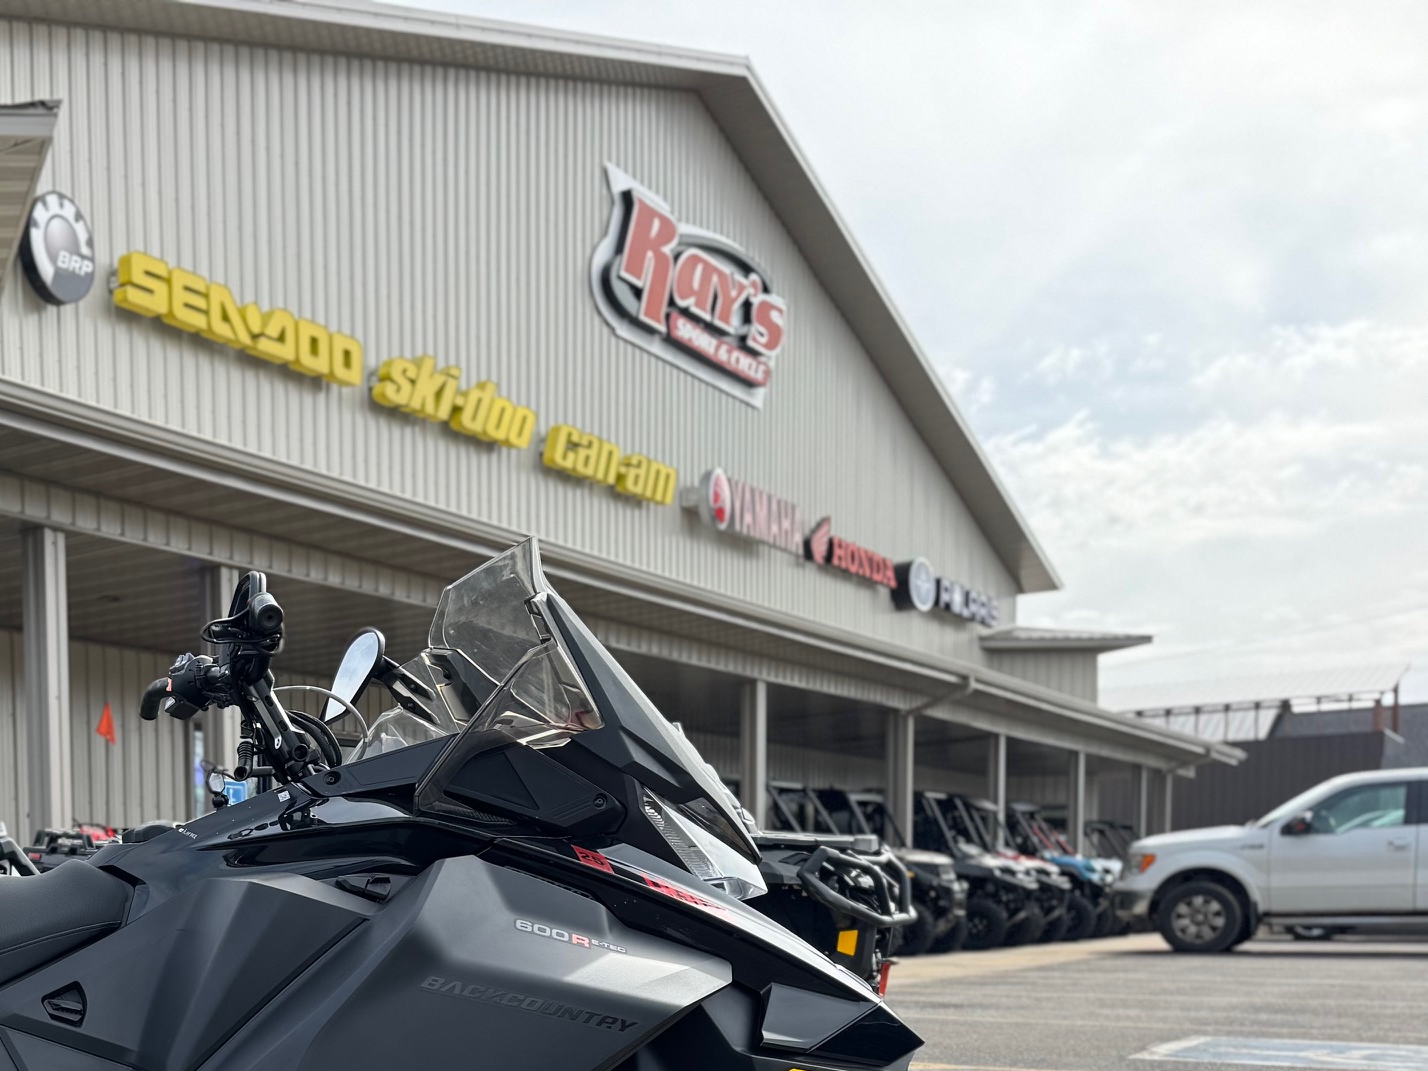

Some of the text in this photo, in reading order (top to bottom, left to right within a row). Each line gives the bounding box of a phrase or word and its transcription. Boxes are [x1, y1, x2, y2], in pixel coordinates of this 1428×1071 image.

[57, 249, 94, 276] BRP
[675, 317, 718, 352] SPORT
[729, 349, 766, 380] CYCLE
[728, 477, 804, 551] YAMAHA
[831, 537, 897, 589] HONDA
[591, 939, 627, 953] E-TEC
[421, 976, 639, 1032] BACKCOUNTRY
